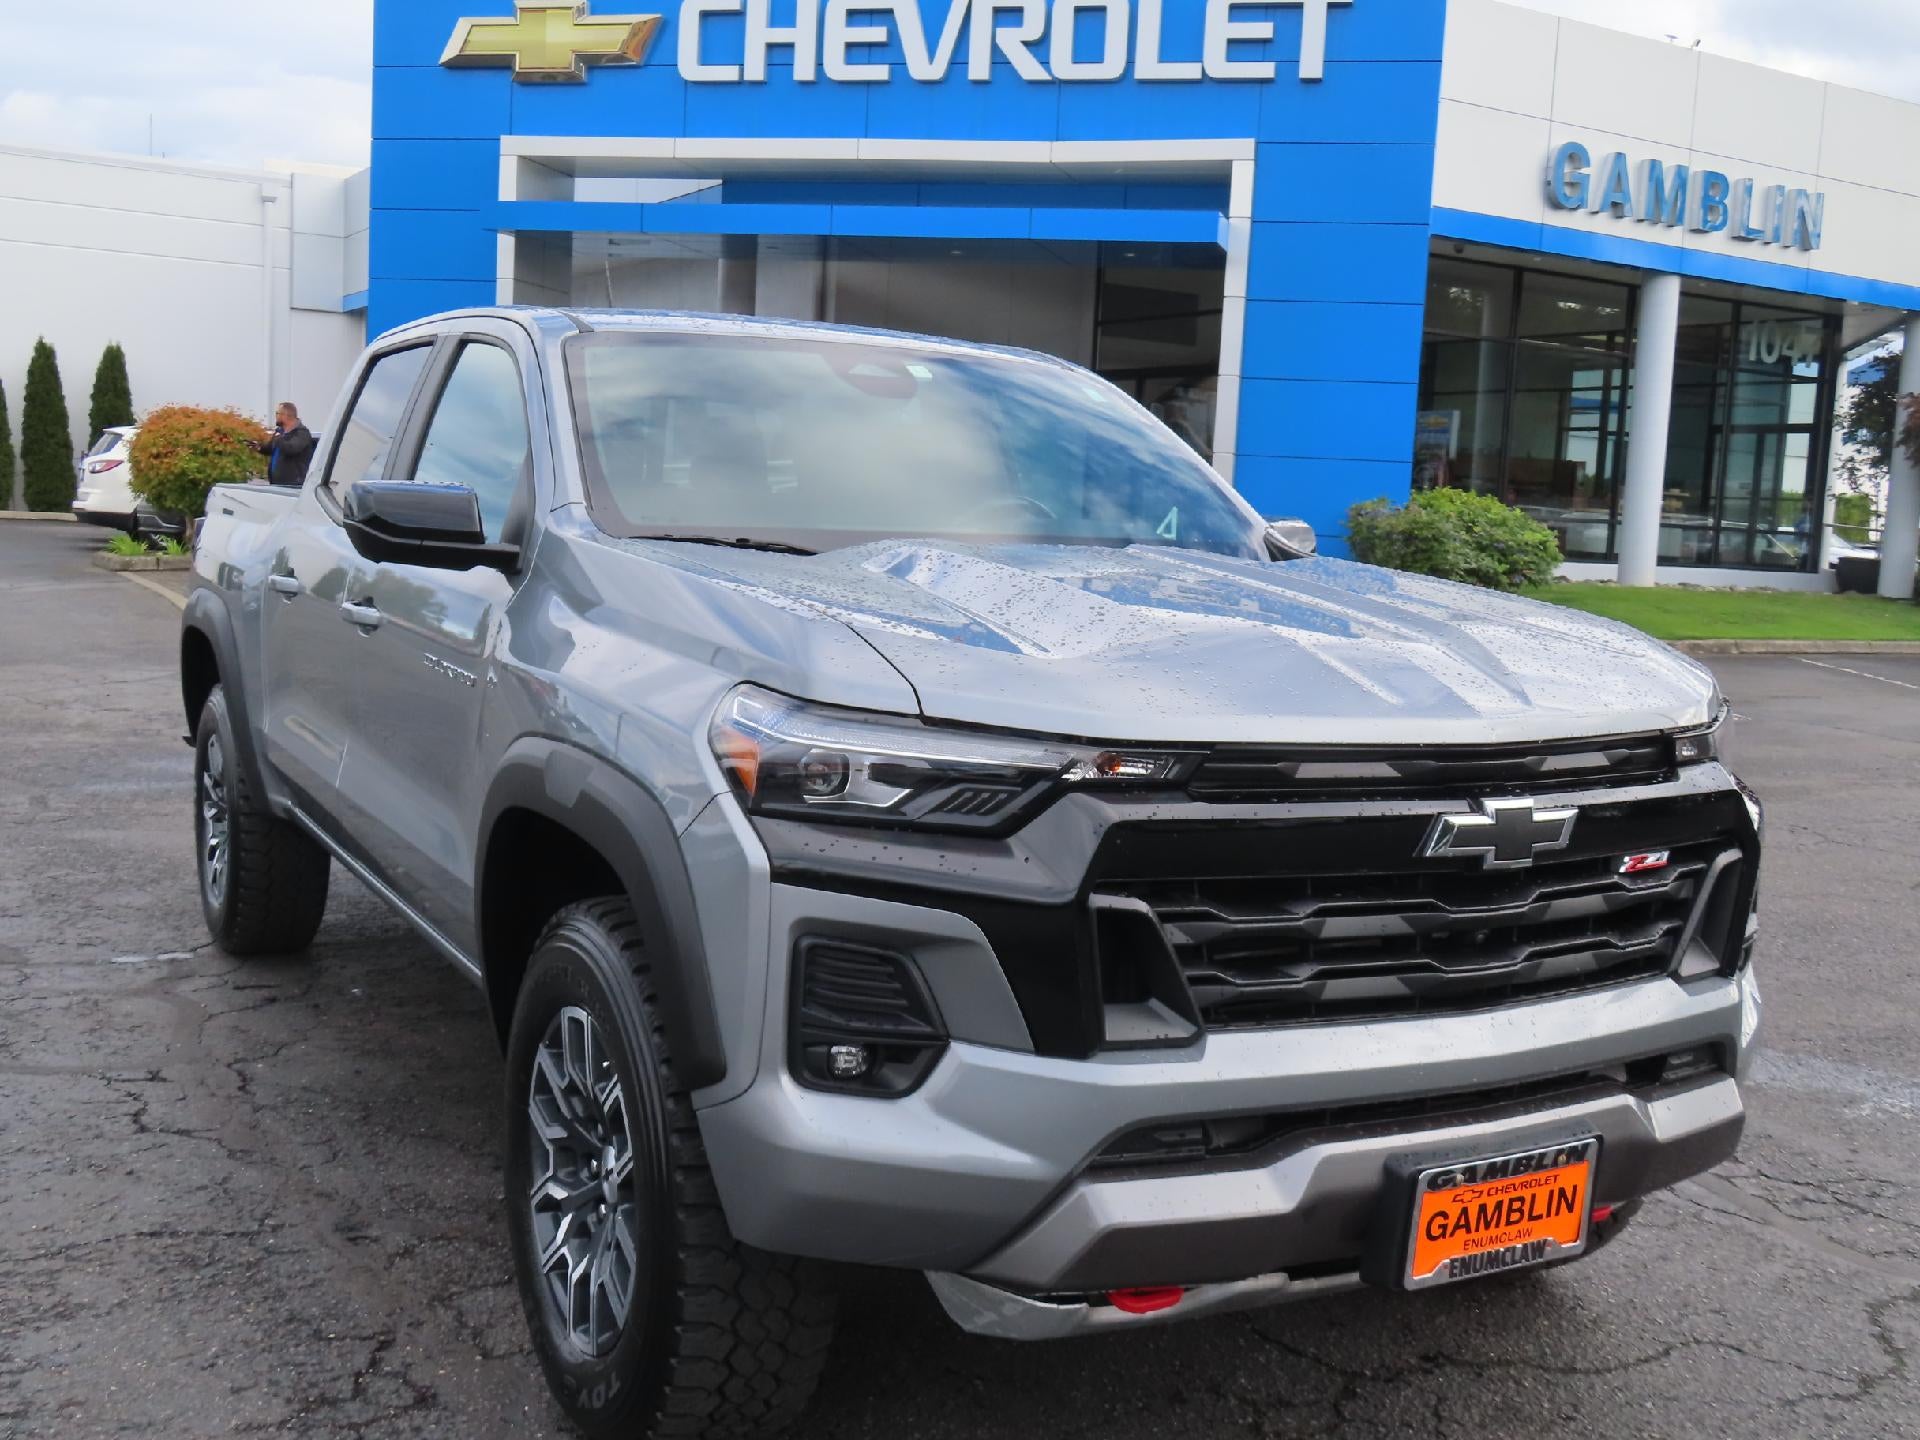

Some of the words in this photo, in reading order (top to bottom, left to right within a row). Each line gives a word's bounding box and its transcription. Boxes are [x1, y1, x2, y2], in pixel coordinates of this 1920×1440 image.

[677, 0, 1353, 82] CHEVROLET
[1546, 141, 1824, 251] GAMBLIN
[1486, 1174, 1560, 1197] CHEVROLET
[1425, 1184, 1578, 1241] GAMBLIN
[1448, 1238, 1548, 1279] ENUMCLAW
[1463, 1227, 1533, 1251] ENUMCLAW
